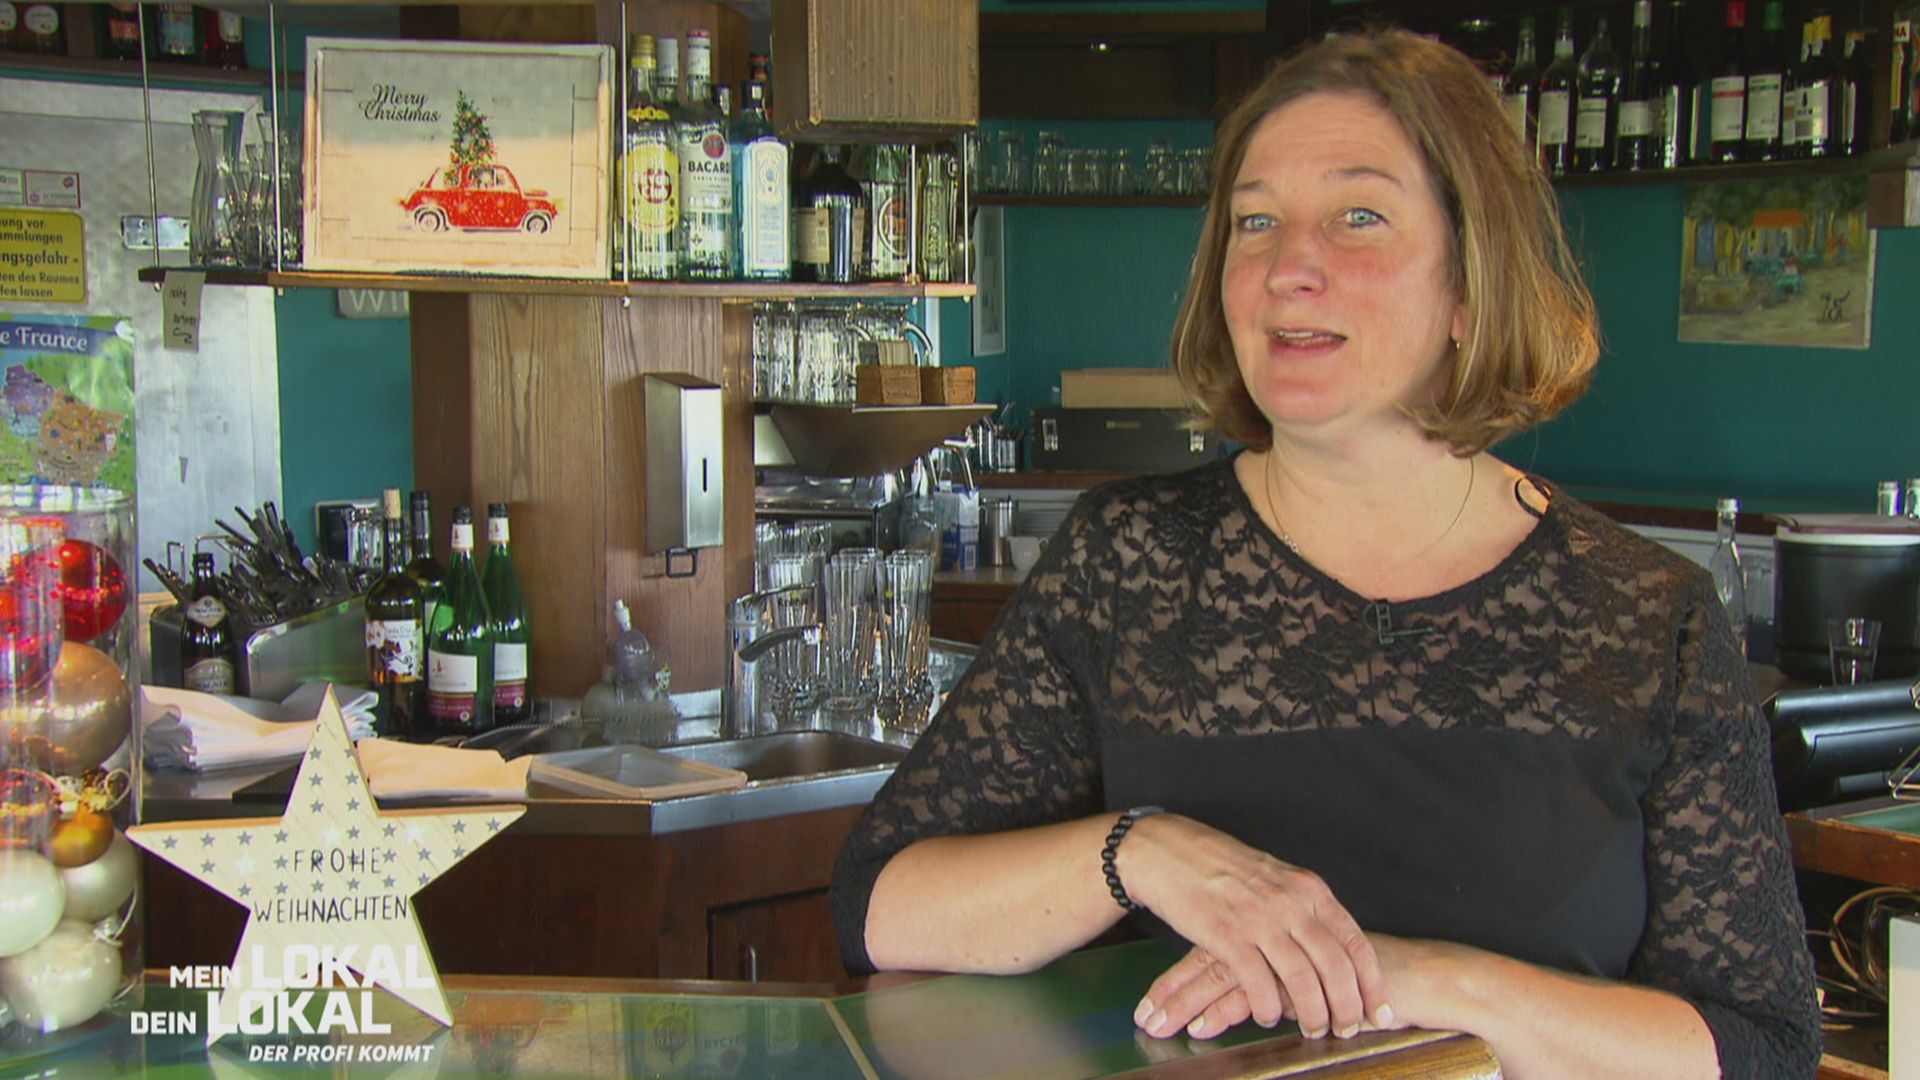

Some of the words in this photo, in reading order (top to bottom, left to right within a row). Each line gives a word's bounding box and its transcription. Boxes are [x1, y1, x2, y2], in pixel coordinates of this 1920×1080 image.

[371, 83, 428, 109] Merry
[358, 99, 441, 122] Christmas
[26, 219, 44, 229] vor
[18, 271, 36, 283] des
[39, 271, 80, 284] Raumes
[20, 284, 53, 297] lassen
[15, 325, 88, 351] France
[293, 848, 381, 873] FROHE
[254, 895, 408, 923] WEIHNACHTEN
